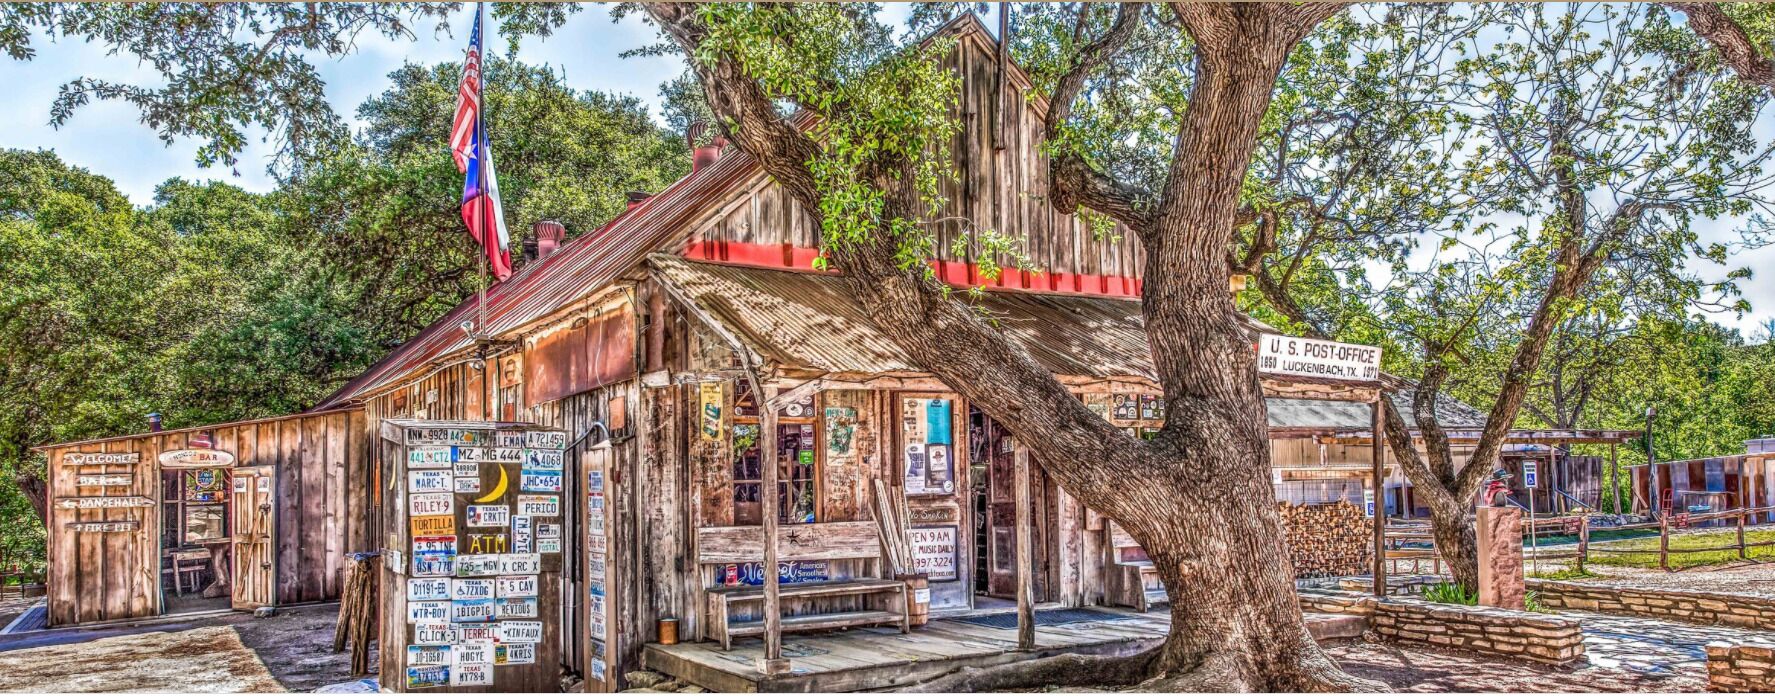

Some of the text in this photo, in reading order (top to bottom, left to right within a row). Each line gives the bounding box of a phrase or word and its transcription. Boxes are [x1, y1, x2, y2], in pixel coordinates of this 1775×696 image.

[1271, 338, 1375, 364] U. S. POST-OFFICE
[71, 453, 132, 464] WELCOME!
[200, 453, 218, 461] BAR
[458, 448, 521, 461] MZ MG 444
[79, 476, 107, 485] BAR
[79, 498, 141, 507] DANCEHALL
[525, 503, 557, 513] PERICO
[85, 523, 132, 532] FIRE PIT
[414, 517, 453, 530] TORTILLA
[907, 531, 927, 543] PEN
[470, 535, 506, 553] ATM
[918, 545, 936, 554] MUSIC
[937, 544, 955, 554] DAILY
[502, 561, 538, 572] X CRC X
[509, 580, 534, 592] 5 CAV
[464, 628, 496, 640] TERRELL
